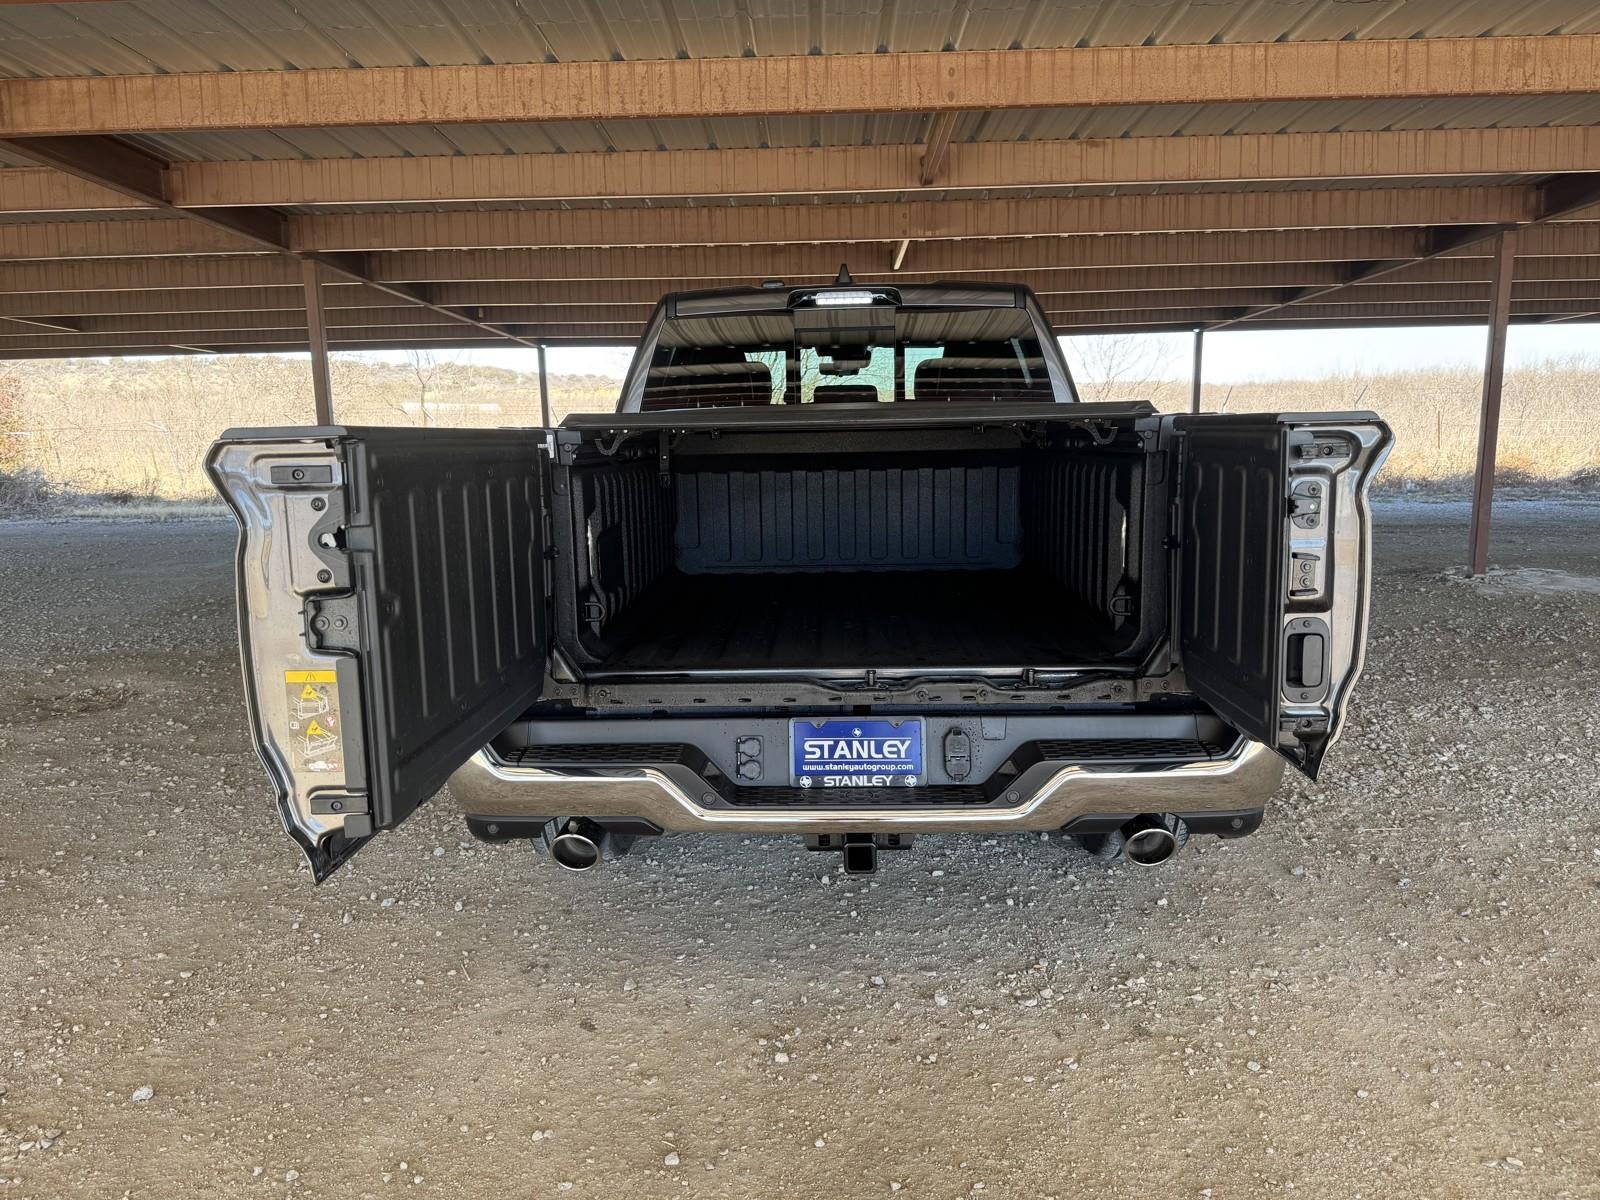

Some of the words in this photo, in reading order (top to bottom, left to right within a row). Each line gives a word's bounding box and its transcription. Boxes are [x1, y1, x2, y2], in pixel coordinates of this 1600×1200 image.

[804, 740, 911, 759] STANLEY
[803, 763, 914, 772] www.stanleyautogroup.com
[823, 775, 893, 787] STANLEY
